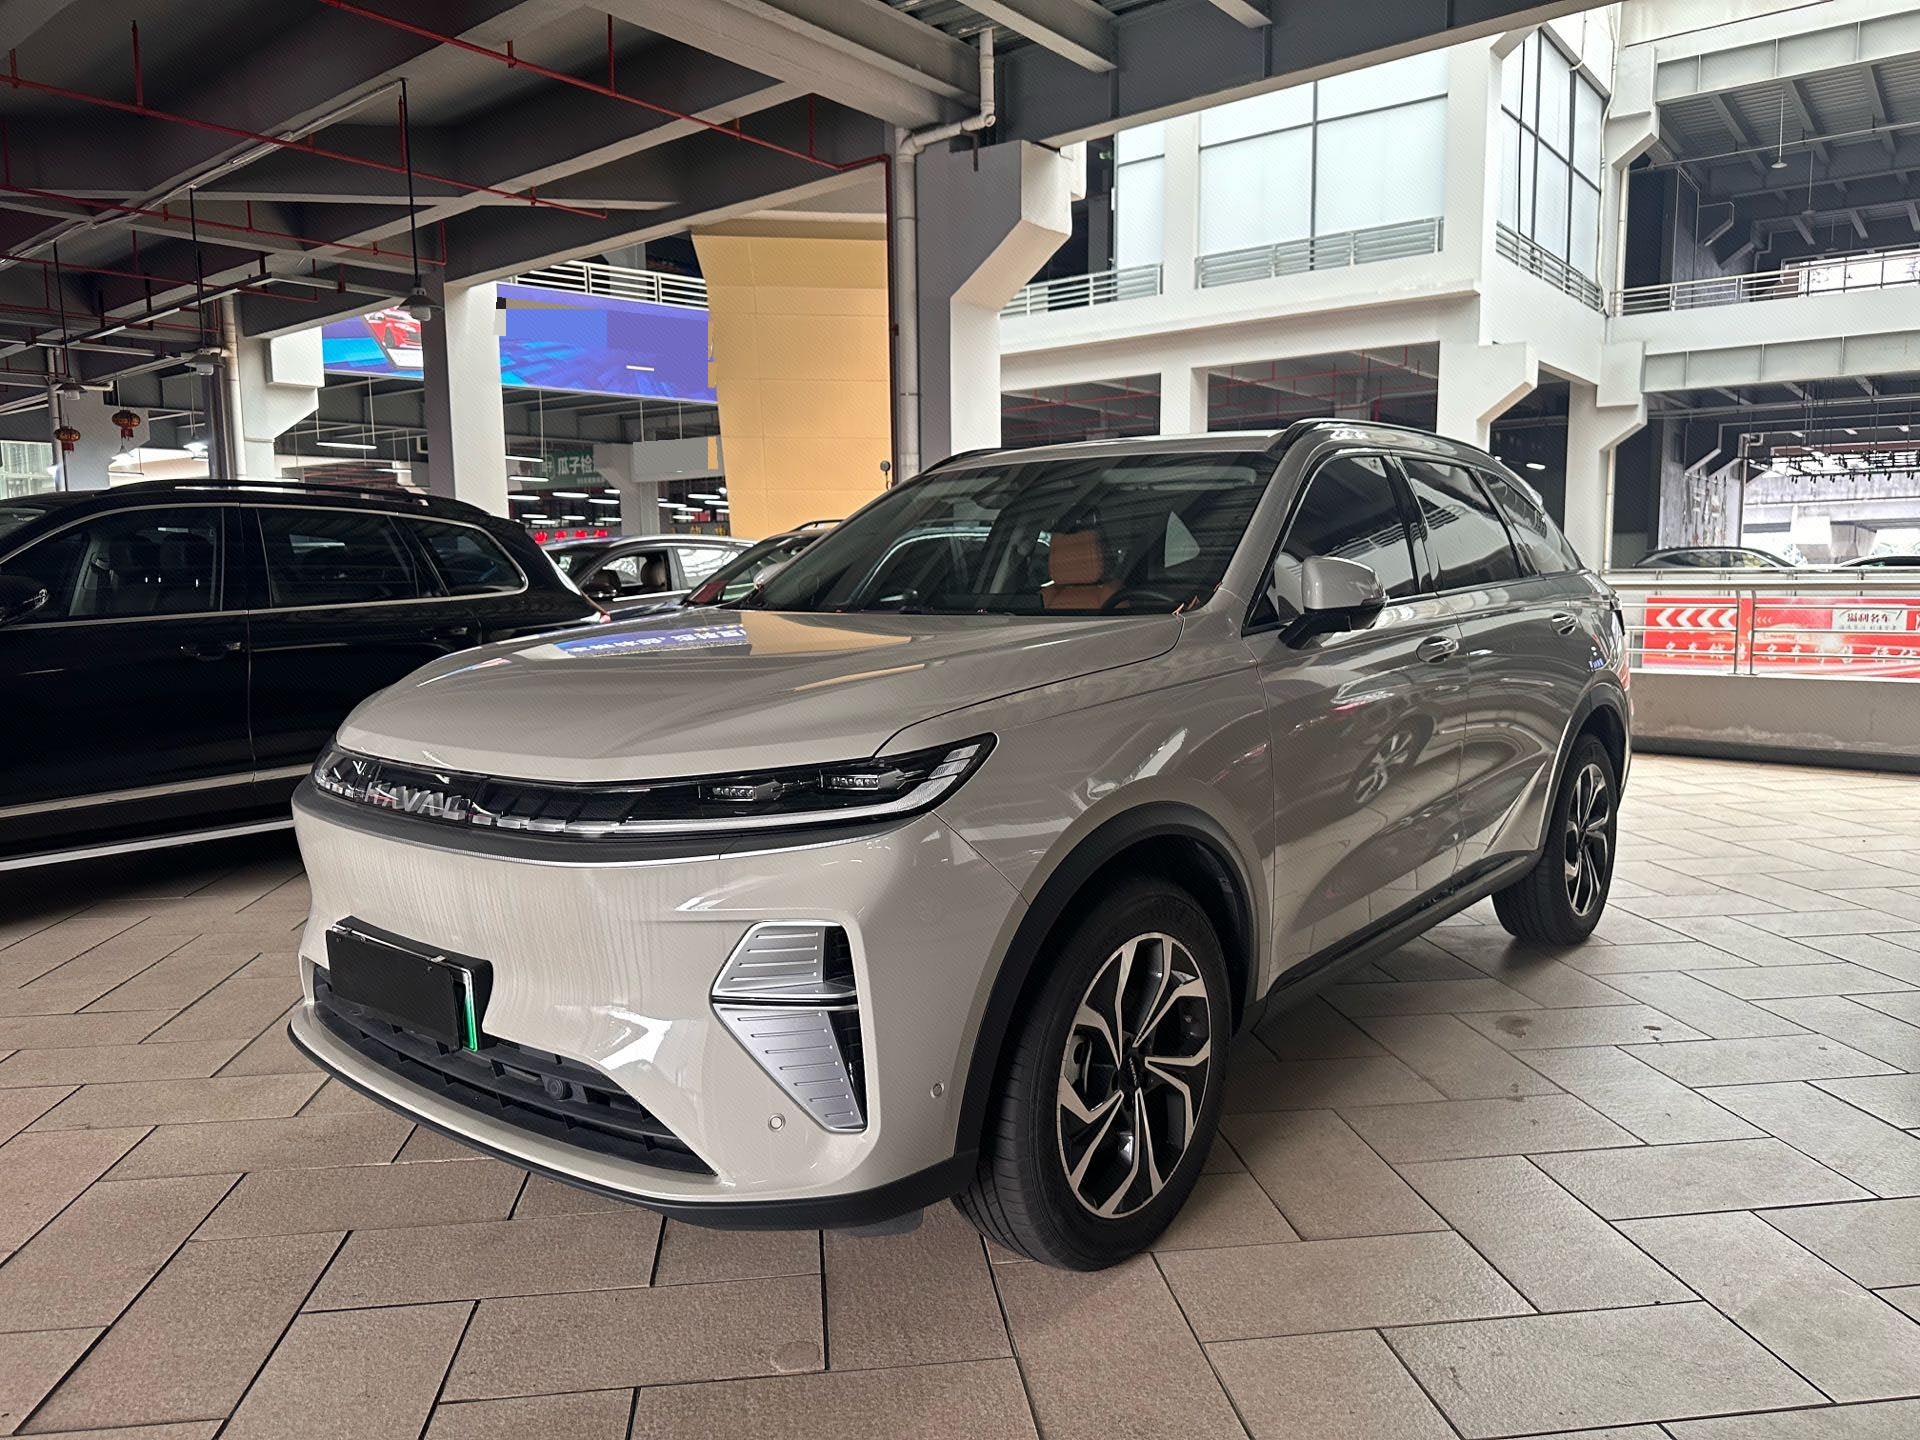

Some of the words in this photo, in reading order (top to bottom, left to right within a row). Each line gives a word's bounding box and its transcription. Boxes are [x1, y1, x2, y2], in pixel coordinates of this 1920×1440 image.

[558, 455, 597, 475] 瓜子检
[365, 781, 466, 820] HAVAL
